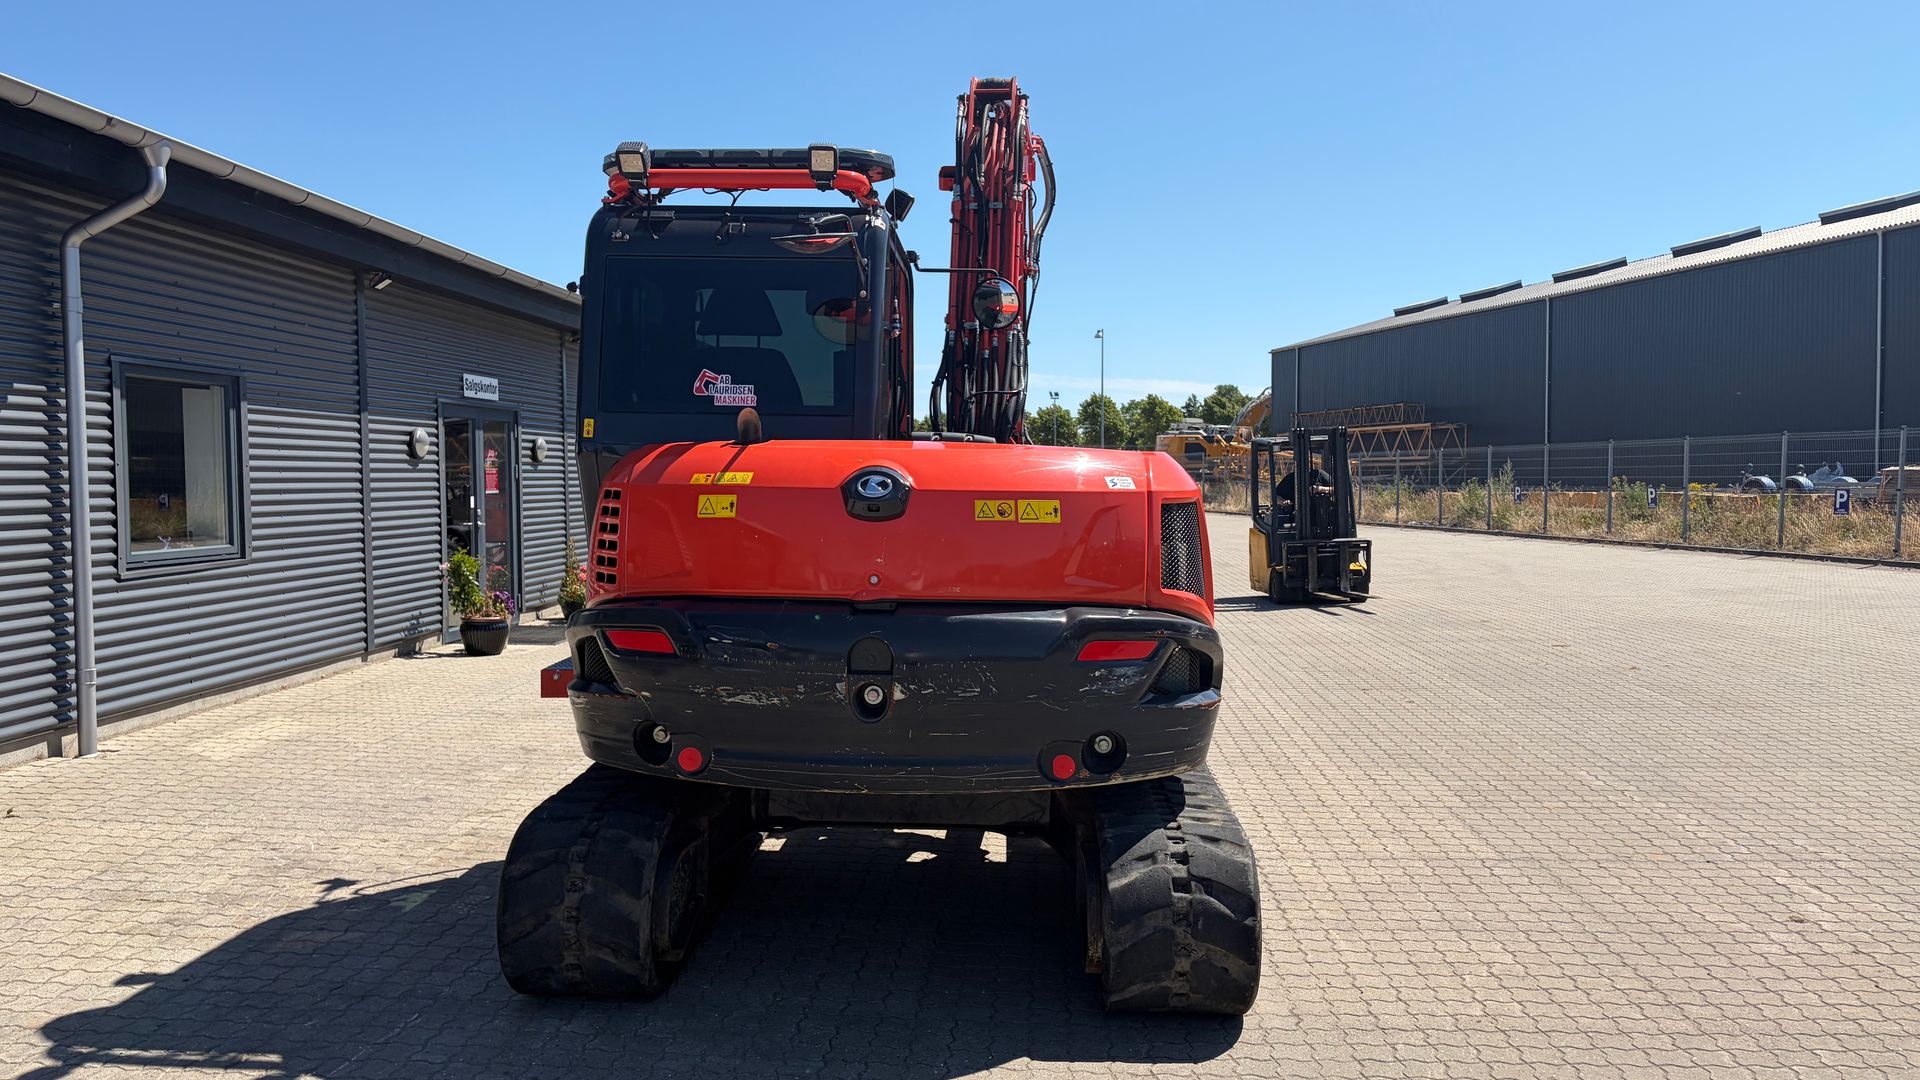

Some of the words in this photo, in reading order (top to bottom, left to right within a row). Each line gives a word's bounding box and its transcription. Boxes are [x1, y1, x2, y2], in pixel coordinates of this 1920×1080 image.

[464, 377, 498, 395] Salgskontor
[719, 375, 731, 385] AB
[709, 385, 753, 395] LAURIDSEN
[715, 395, 756, 405] MASKINER
[1648, 488, 1655, 503] P
[1836, 490, 1847, 508] P
